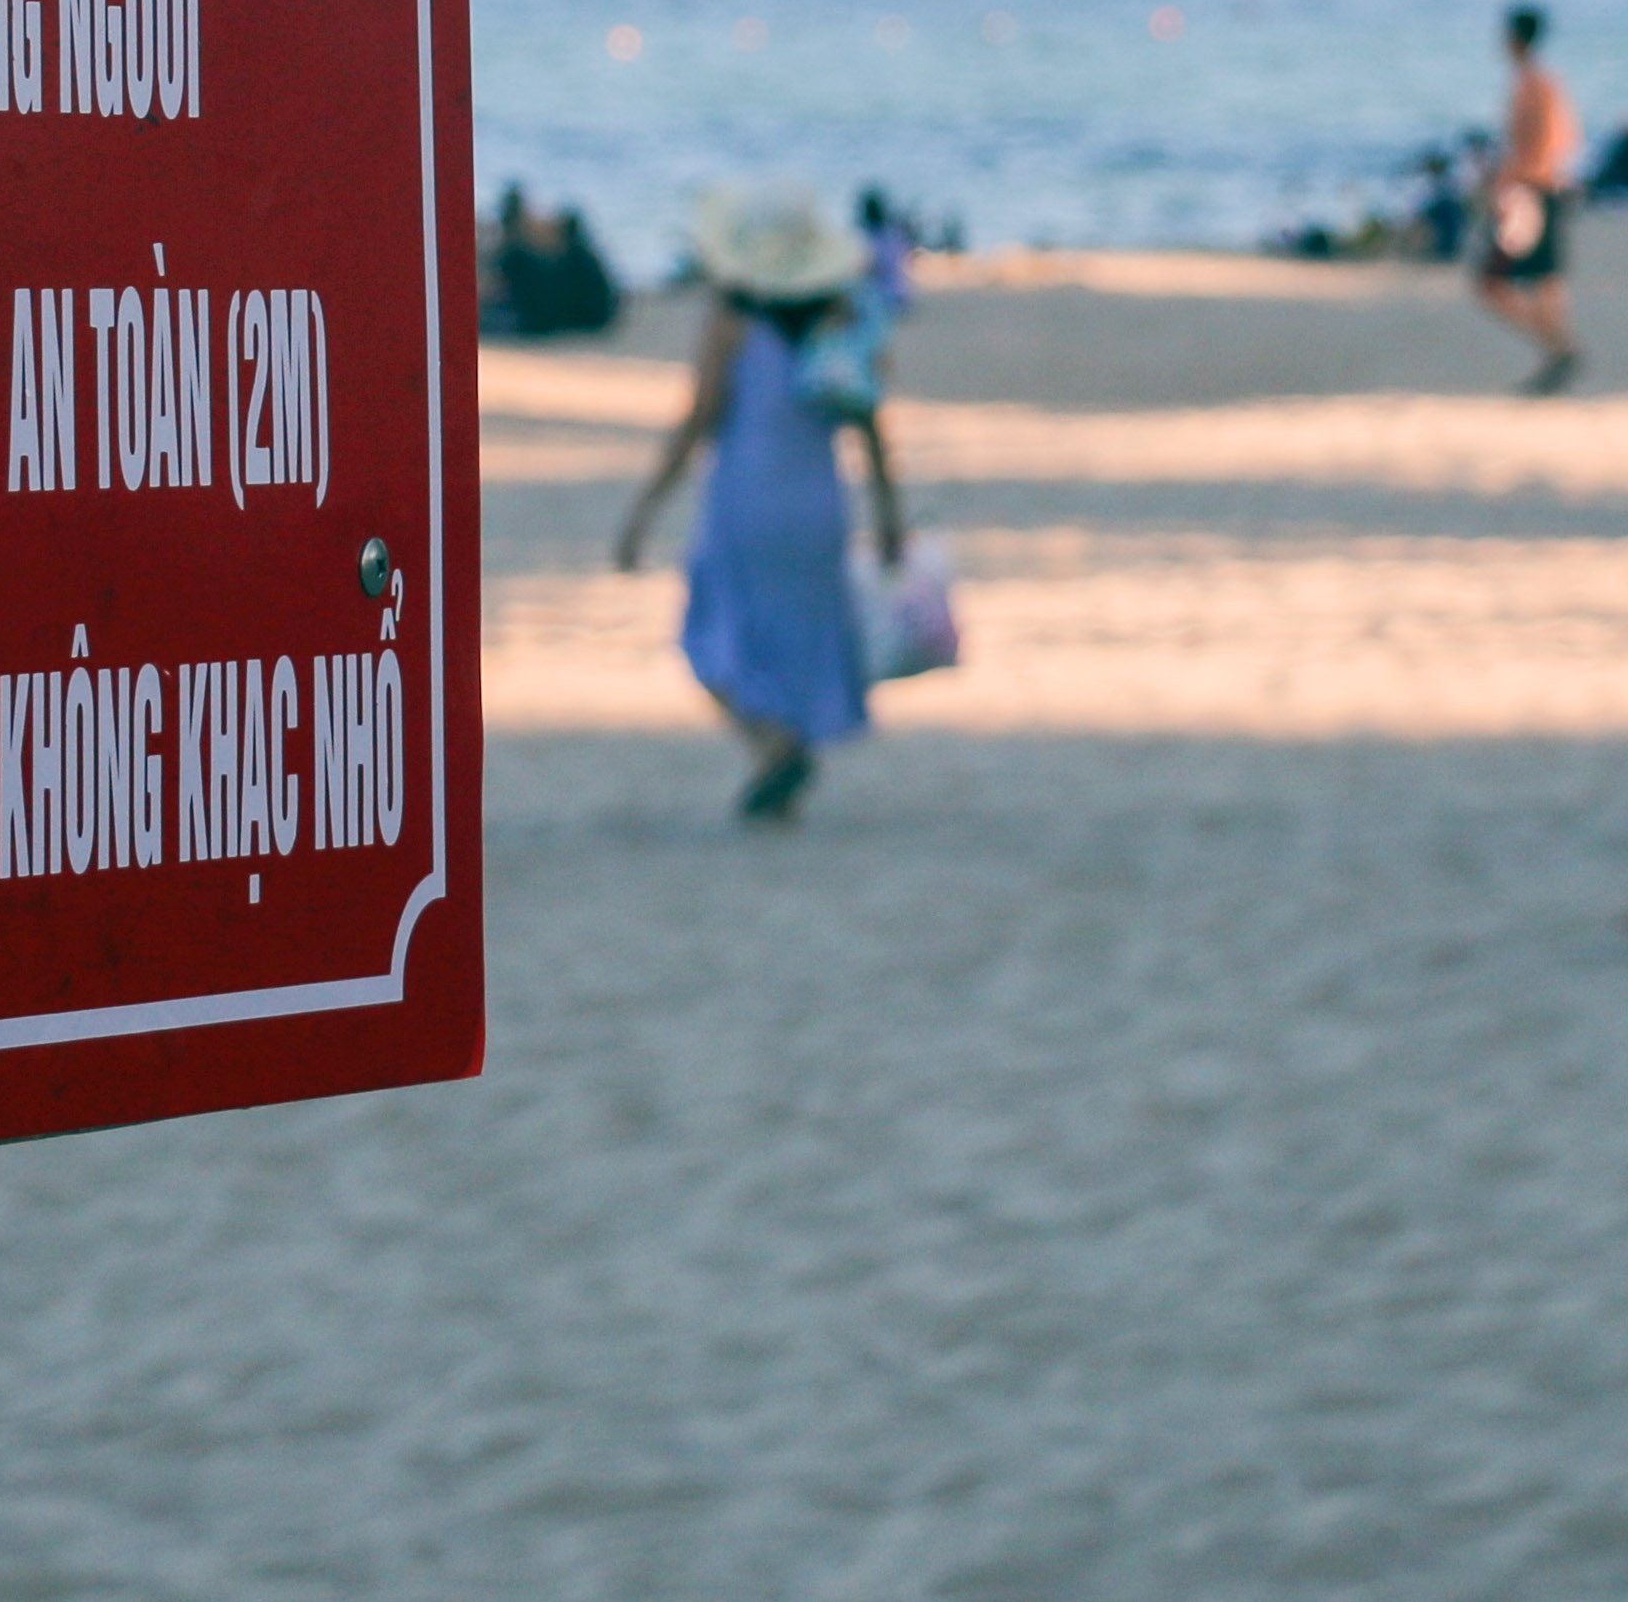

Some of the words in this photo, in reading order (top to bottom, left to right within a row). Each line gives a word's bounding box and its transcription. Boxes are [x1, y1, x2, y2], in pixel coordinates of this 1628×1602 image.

[8, 288, 76, 492] AN
[89, 242, 212, 492] TOÀN
[227, 289, 329, 511] (2M)
[0, 623, 162, 879] KHÔNG
[179, 654, 298, 904] KHẠC
[313, 568, 404, 847] NHỔ
